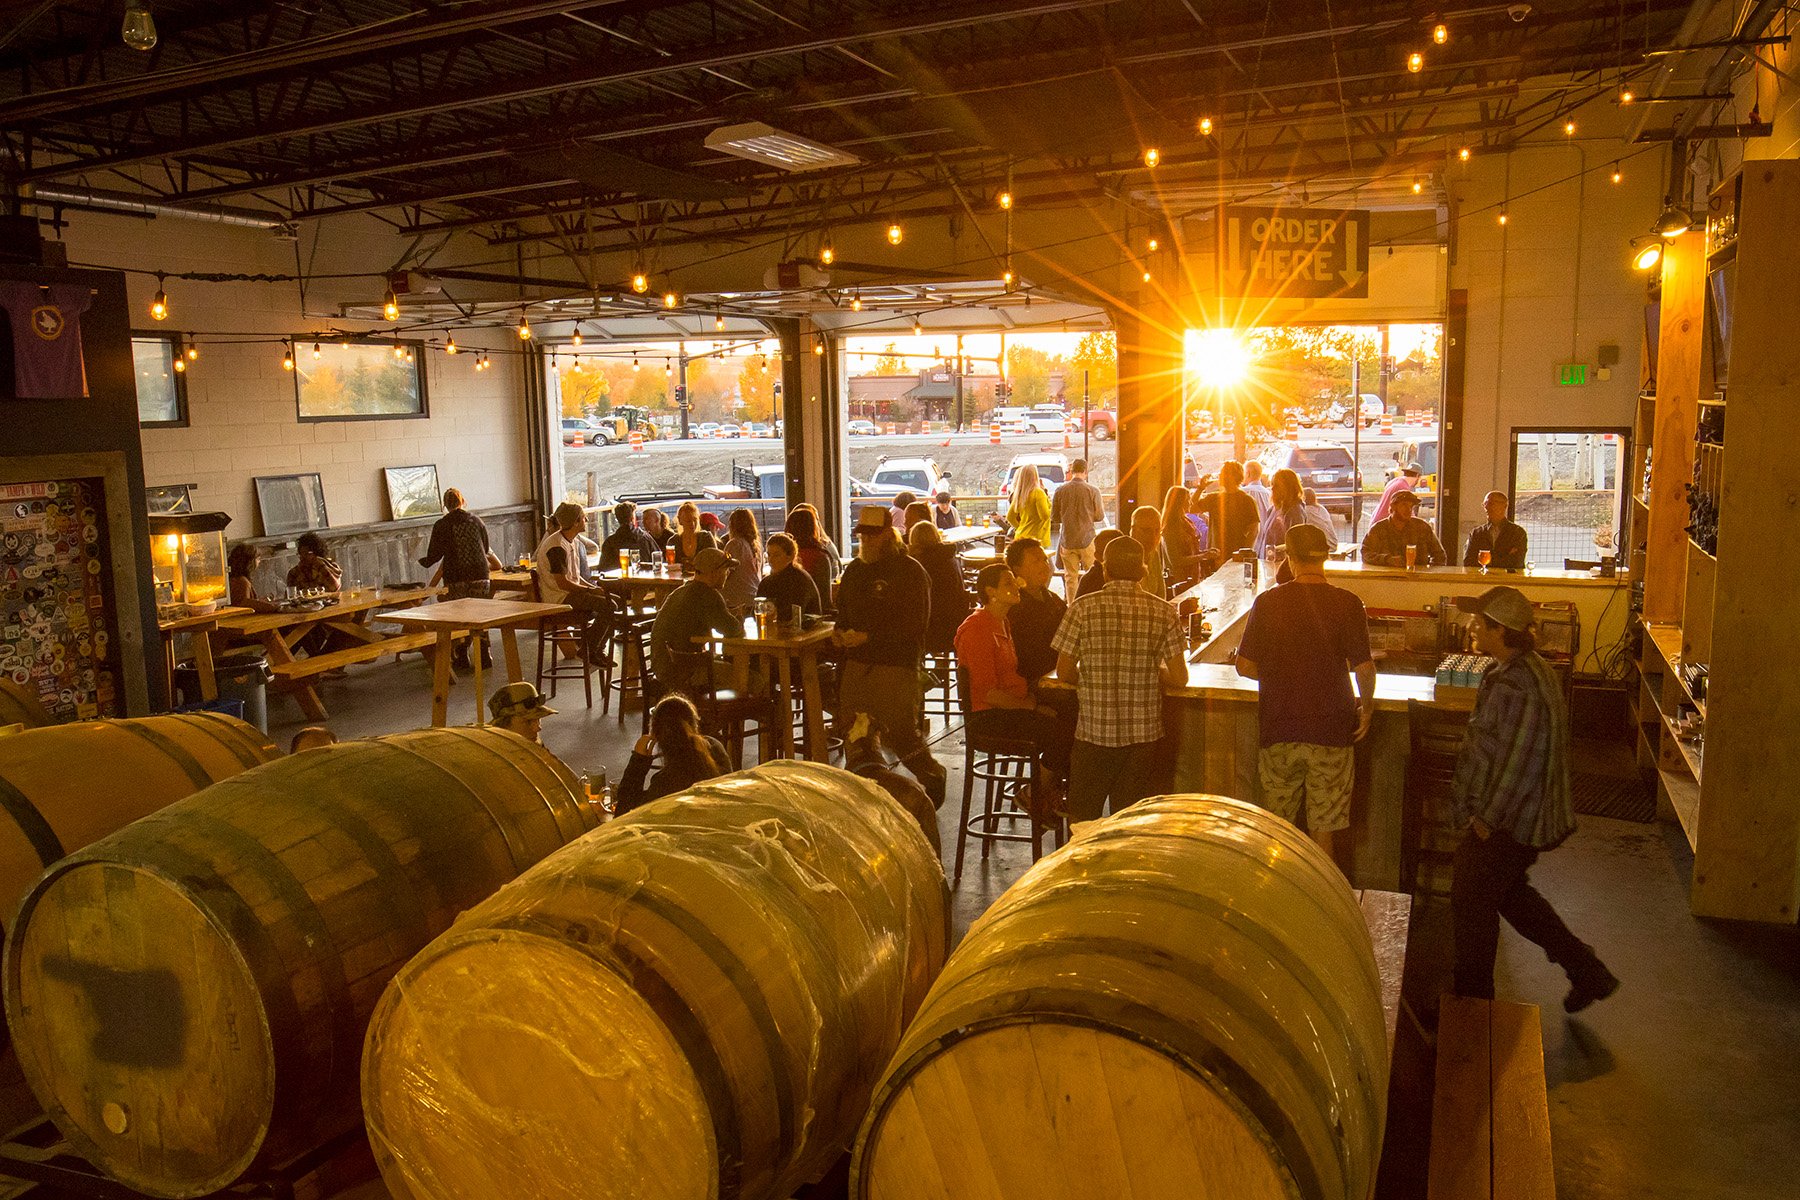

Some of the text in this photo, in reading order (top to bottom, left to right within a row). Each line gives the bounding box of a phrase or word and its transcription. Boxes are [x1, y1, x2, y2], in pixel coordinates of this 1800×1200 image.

[1251, 217, 1335, 244] ORDER
[1251, 250, 1333, 281] HERE
[1561, 365, 1588, 385] EXIT
